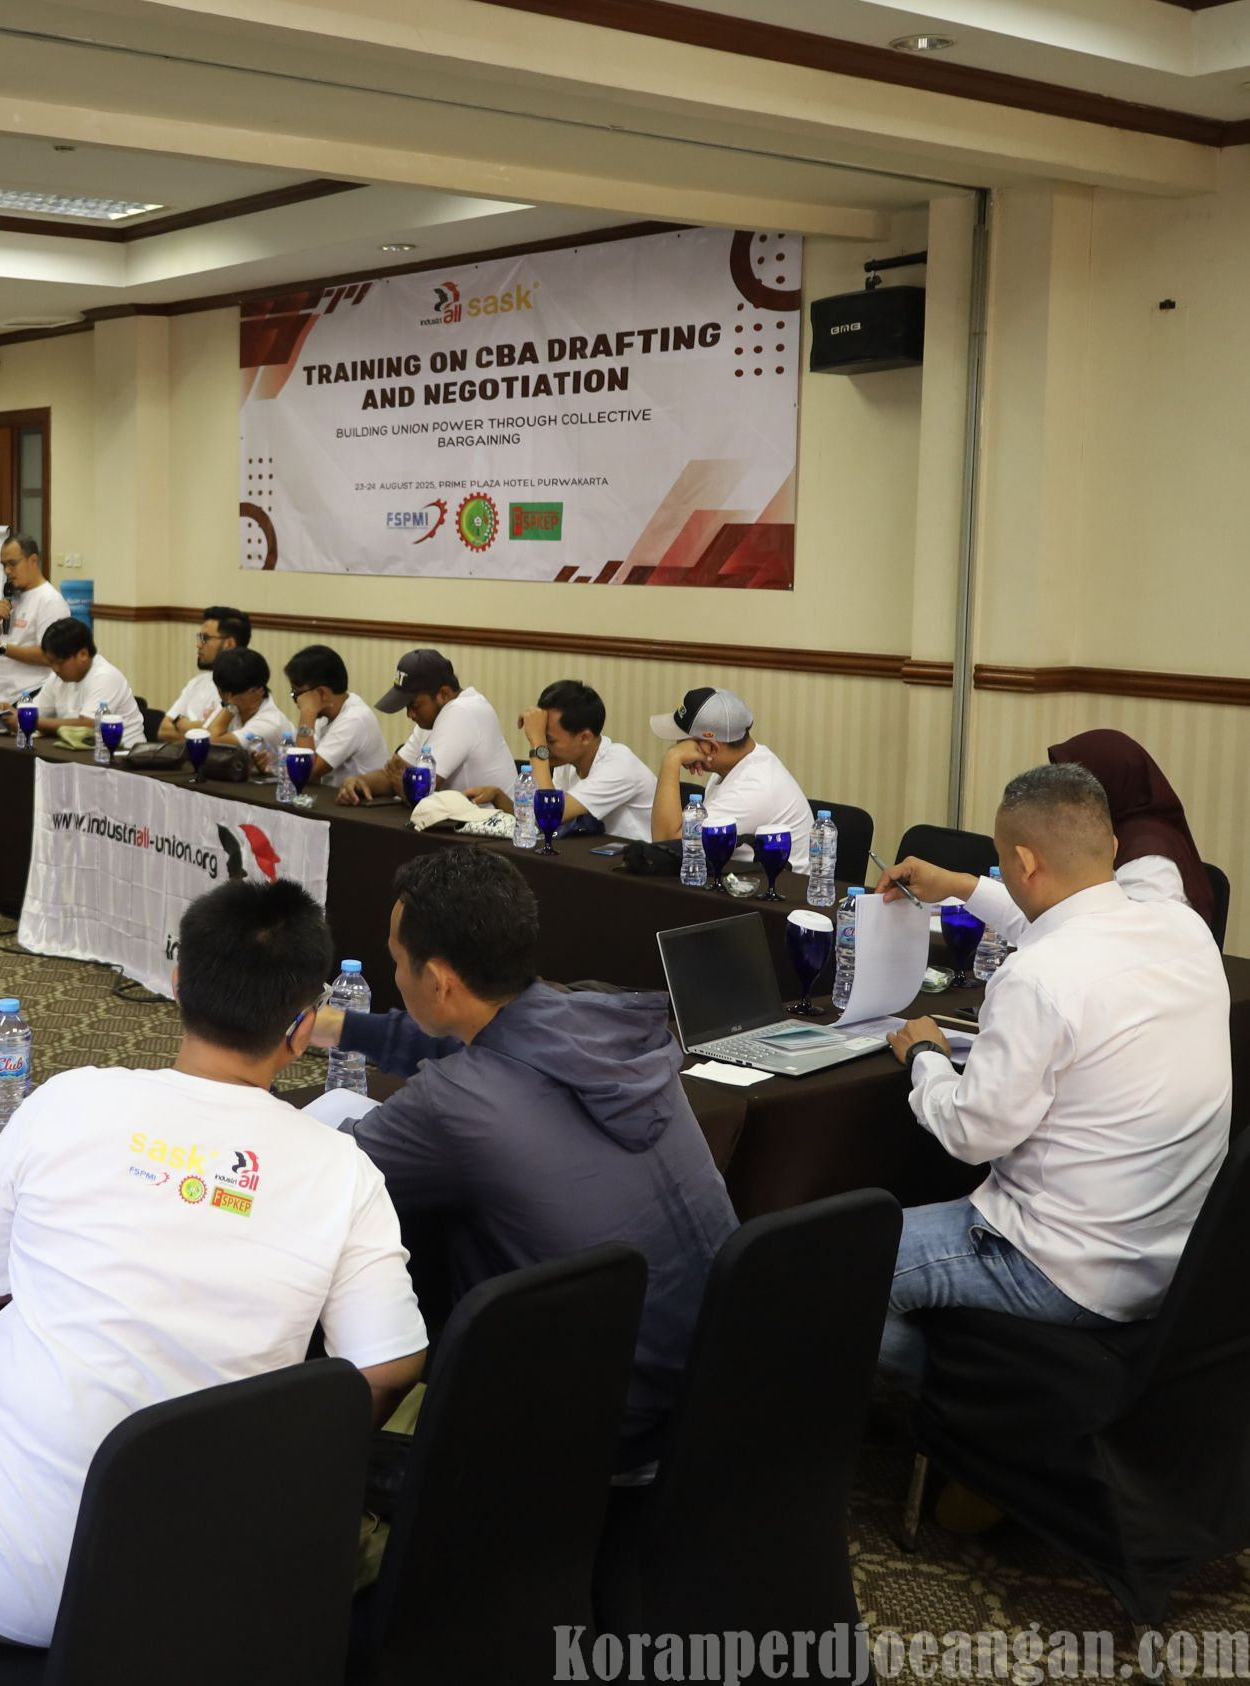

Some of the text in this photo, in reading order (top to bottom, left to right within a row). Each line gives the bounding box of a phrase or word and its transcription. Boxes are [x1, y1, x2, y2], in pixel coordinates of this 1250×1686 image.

[467, 284, 532, 317] sask
[303, 322, 722, 386] TRAINING ON CBA DRAFTING
[361, 366, 629, 410] AND NEGOTIATION
[336, 408, 652, 438] BUILDING UNION POWER THROUGH COLLECTIVE
[437, 433, 521, 448] BARGAINING
[354, 483, 376, 491] 23-24
[380, 482, 413, 490] AUGUST
[439, 480, 466, 489] PRIME
[470, 479, 500, 488] PLAZA
[503, 478, 535, 487] HOTEL
[537, 477, 609, 486] PURWAKARTA
[386, 512, 429, 527] FSPMI
[129, 1131, 205, 1175] sask
